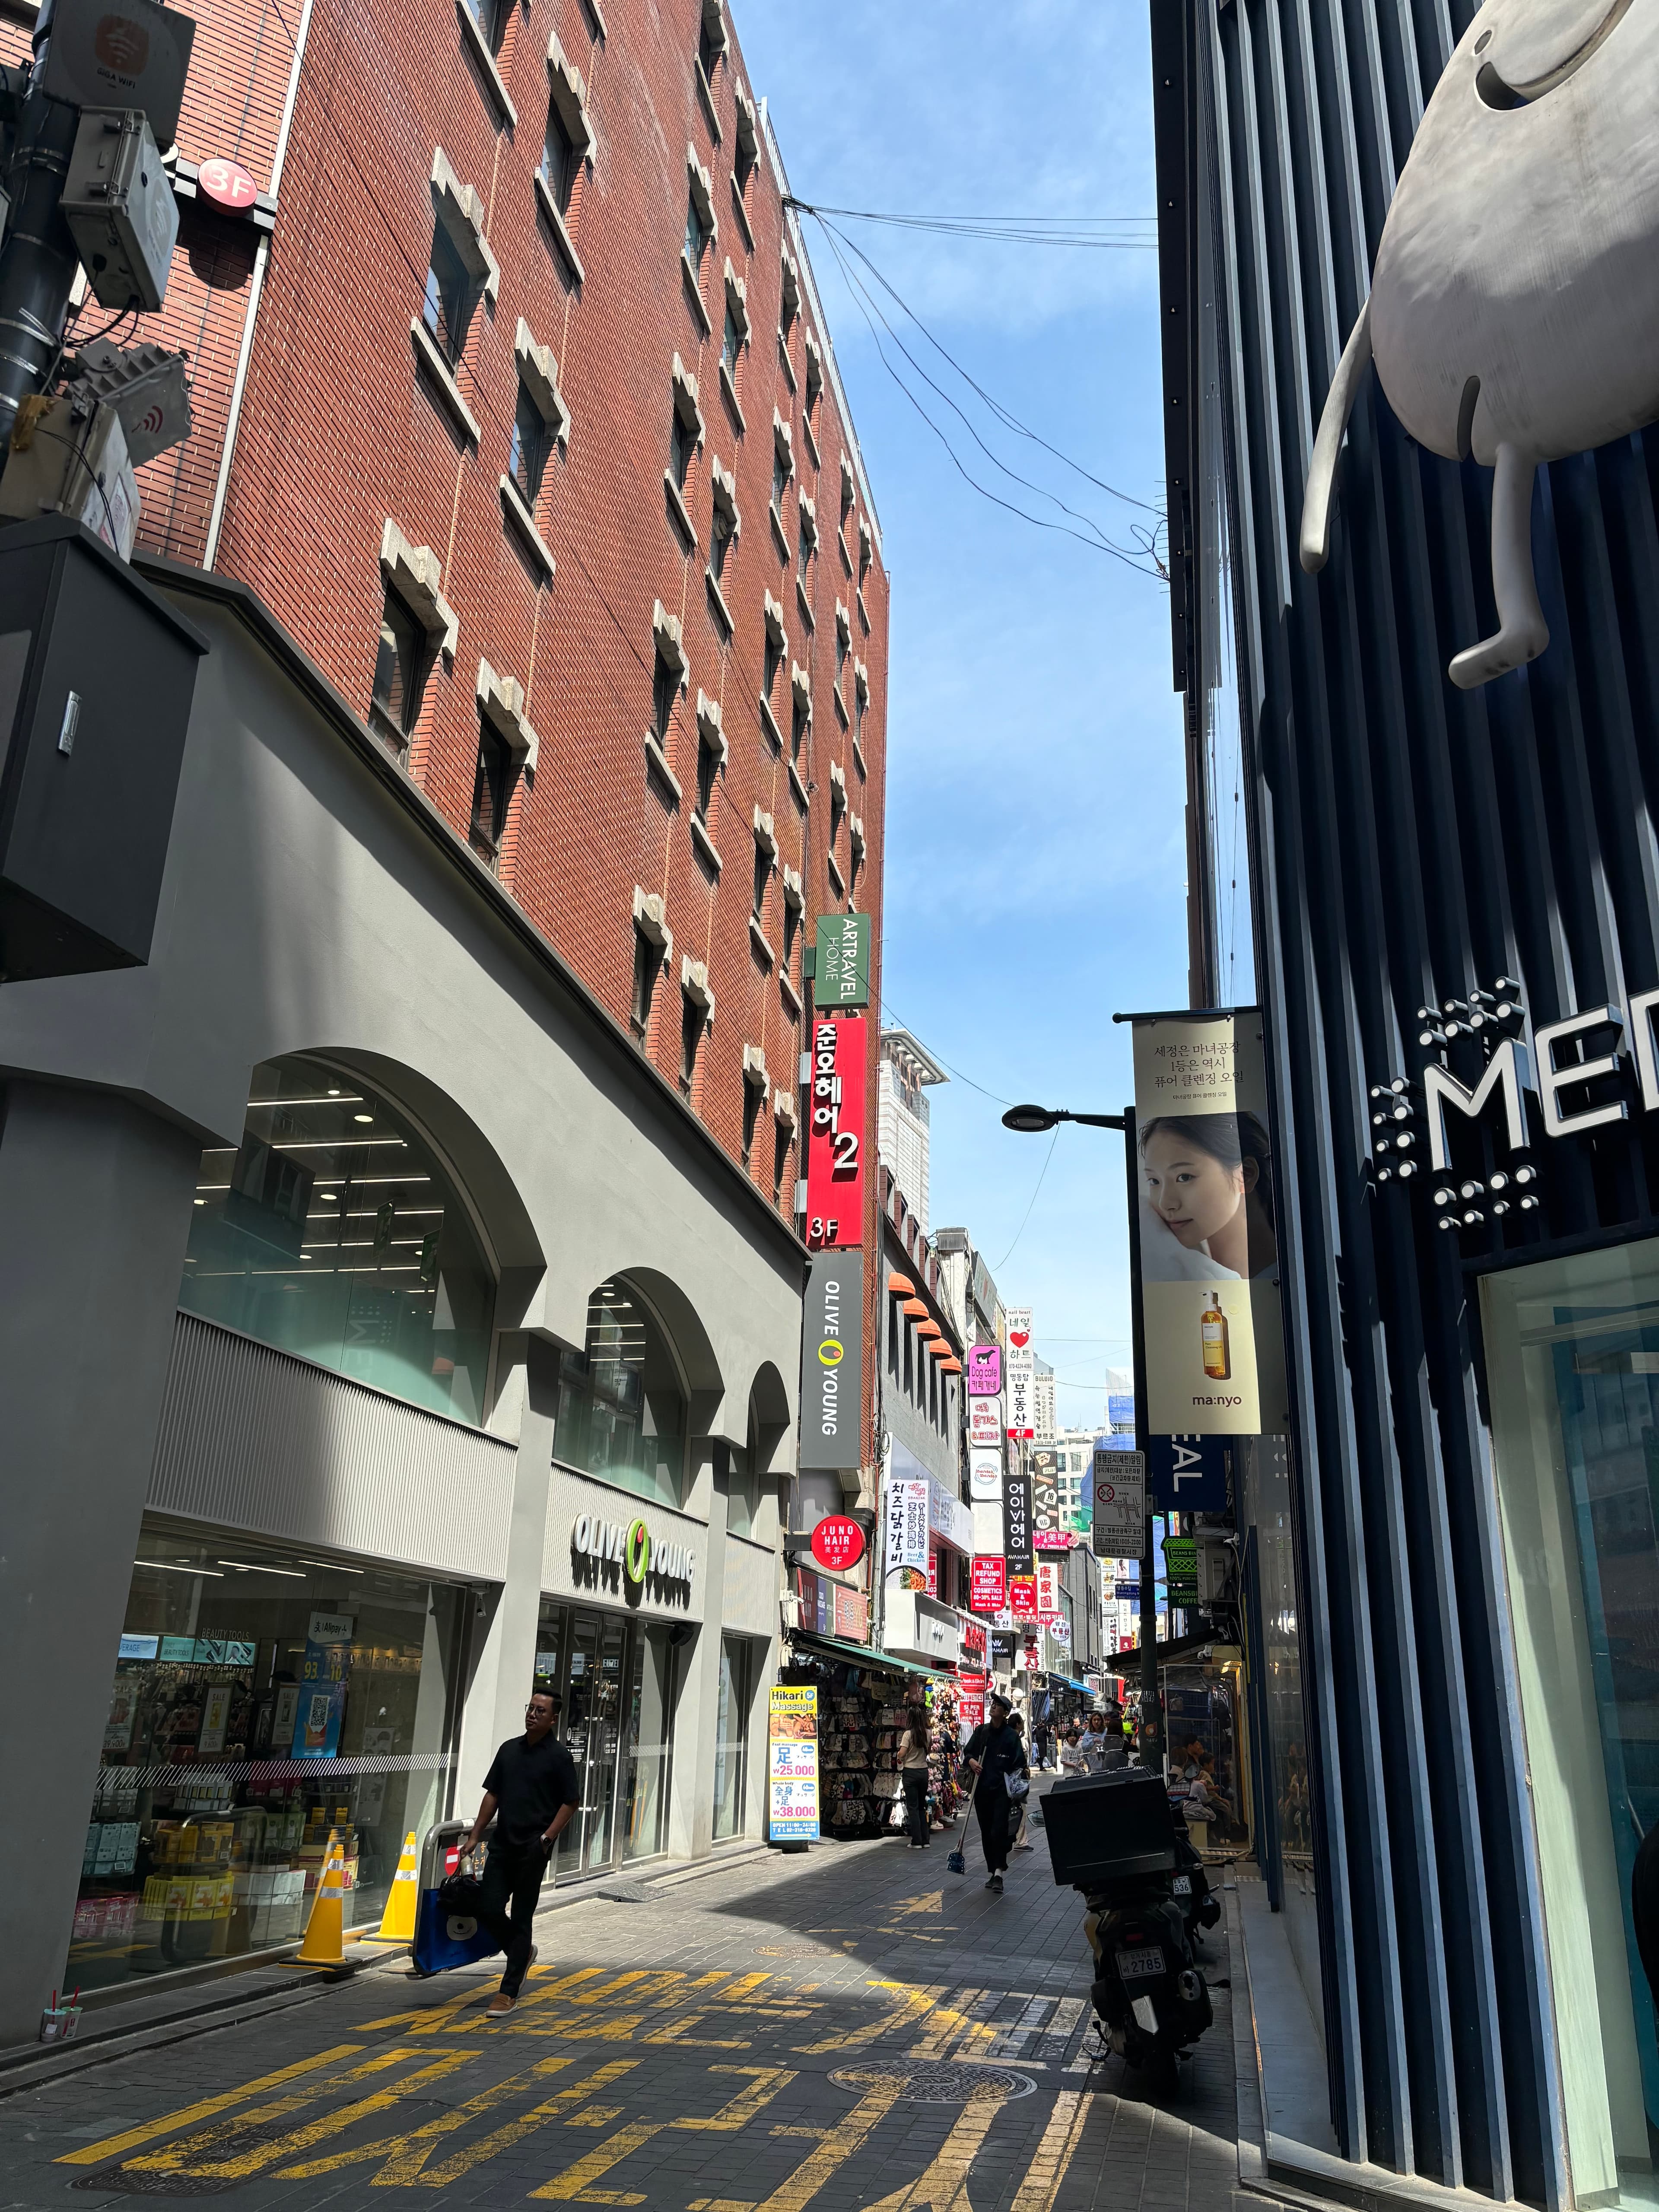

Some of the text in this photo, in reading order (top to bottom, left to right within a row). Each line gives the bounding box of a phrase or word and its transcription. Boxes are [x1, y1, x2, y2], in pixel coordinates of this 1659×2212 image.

[206, 168, 253, 198] 3F
[826, 937, 839, 981] HOME
[840, 918, 858, 1000] ARTRAVEL
[1154, 1041, 1241, 1058] 세정은 마녀공장
[1171, 1057, 1226, 1072] 1등은 역시
[1154, 1070, 1244, 1088] 퓨어 클렌징 오일
[1424, 987, 1659, 1172] ME
[814, 1023, 859, 1169] 준오헤어 2
[810, 1216, 838, 1237] 3F
[1009, 1317, 1030, 1328] 네일
[821, 1281, 839, 1436] OLIVE YOUNG
[1010, 1350, 1031, 1360] 하트
[972, 1366, 997, 1379] Dog cafe
[1013, 1383, 1027, 1427] 부동산
[1192, 1395, 1242, 1408] ma:nyo
[1015, 1429, 1026, 1438] 4F
[1171, 1434, 1202, 1492] AL
[890, 1482, 904, 1563] 치즈닭갈비
[1009, 1483, 1025, 1549] 에이바헤어
[821, 1525, 854, 1535] JUNO
[571, 1513, 696, 1583] OLIVE YOUNG
[824, 1536, 850, 1545] HAIR
[831, 1556, 842, 1565] 3F
[201, 1627, 250, 1641] BEAUTY TOOLS
[1023, 1634, 1040, 1671] 부동산
[212, 1693, 226, 1701] SALE
[772, 1691, 803, 1701] Hikari
[772, 1701, 814, 1711] Massage
[776, 1747, 792, 1764] 足
[775, 1786, 793, 1796] 全身
[1174, 1884, 1189, 1892] 536
[1131, 1958, 1161, 1973] 2785
